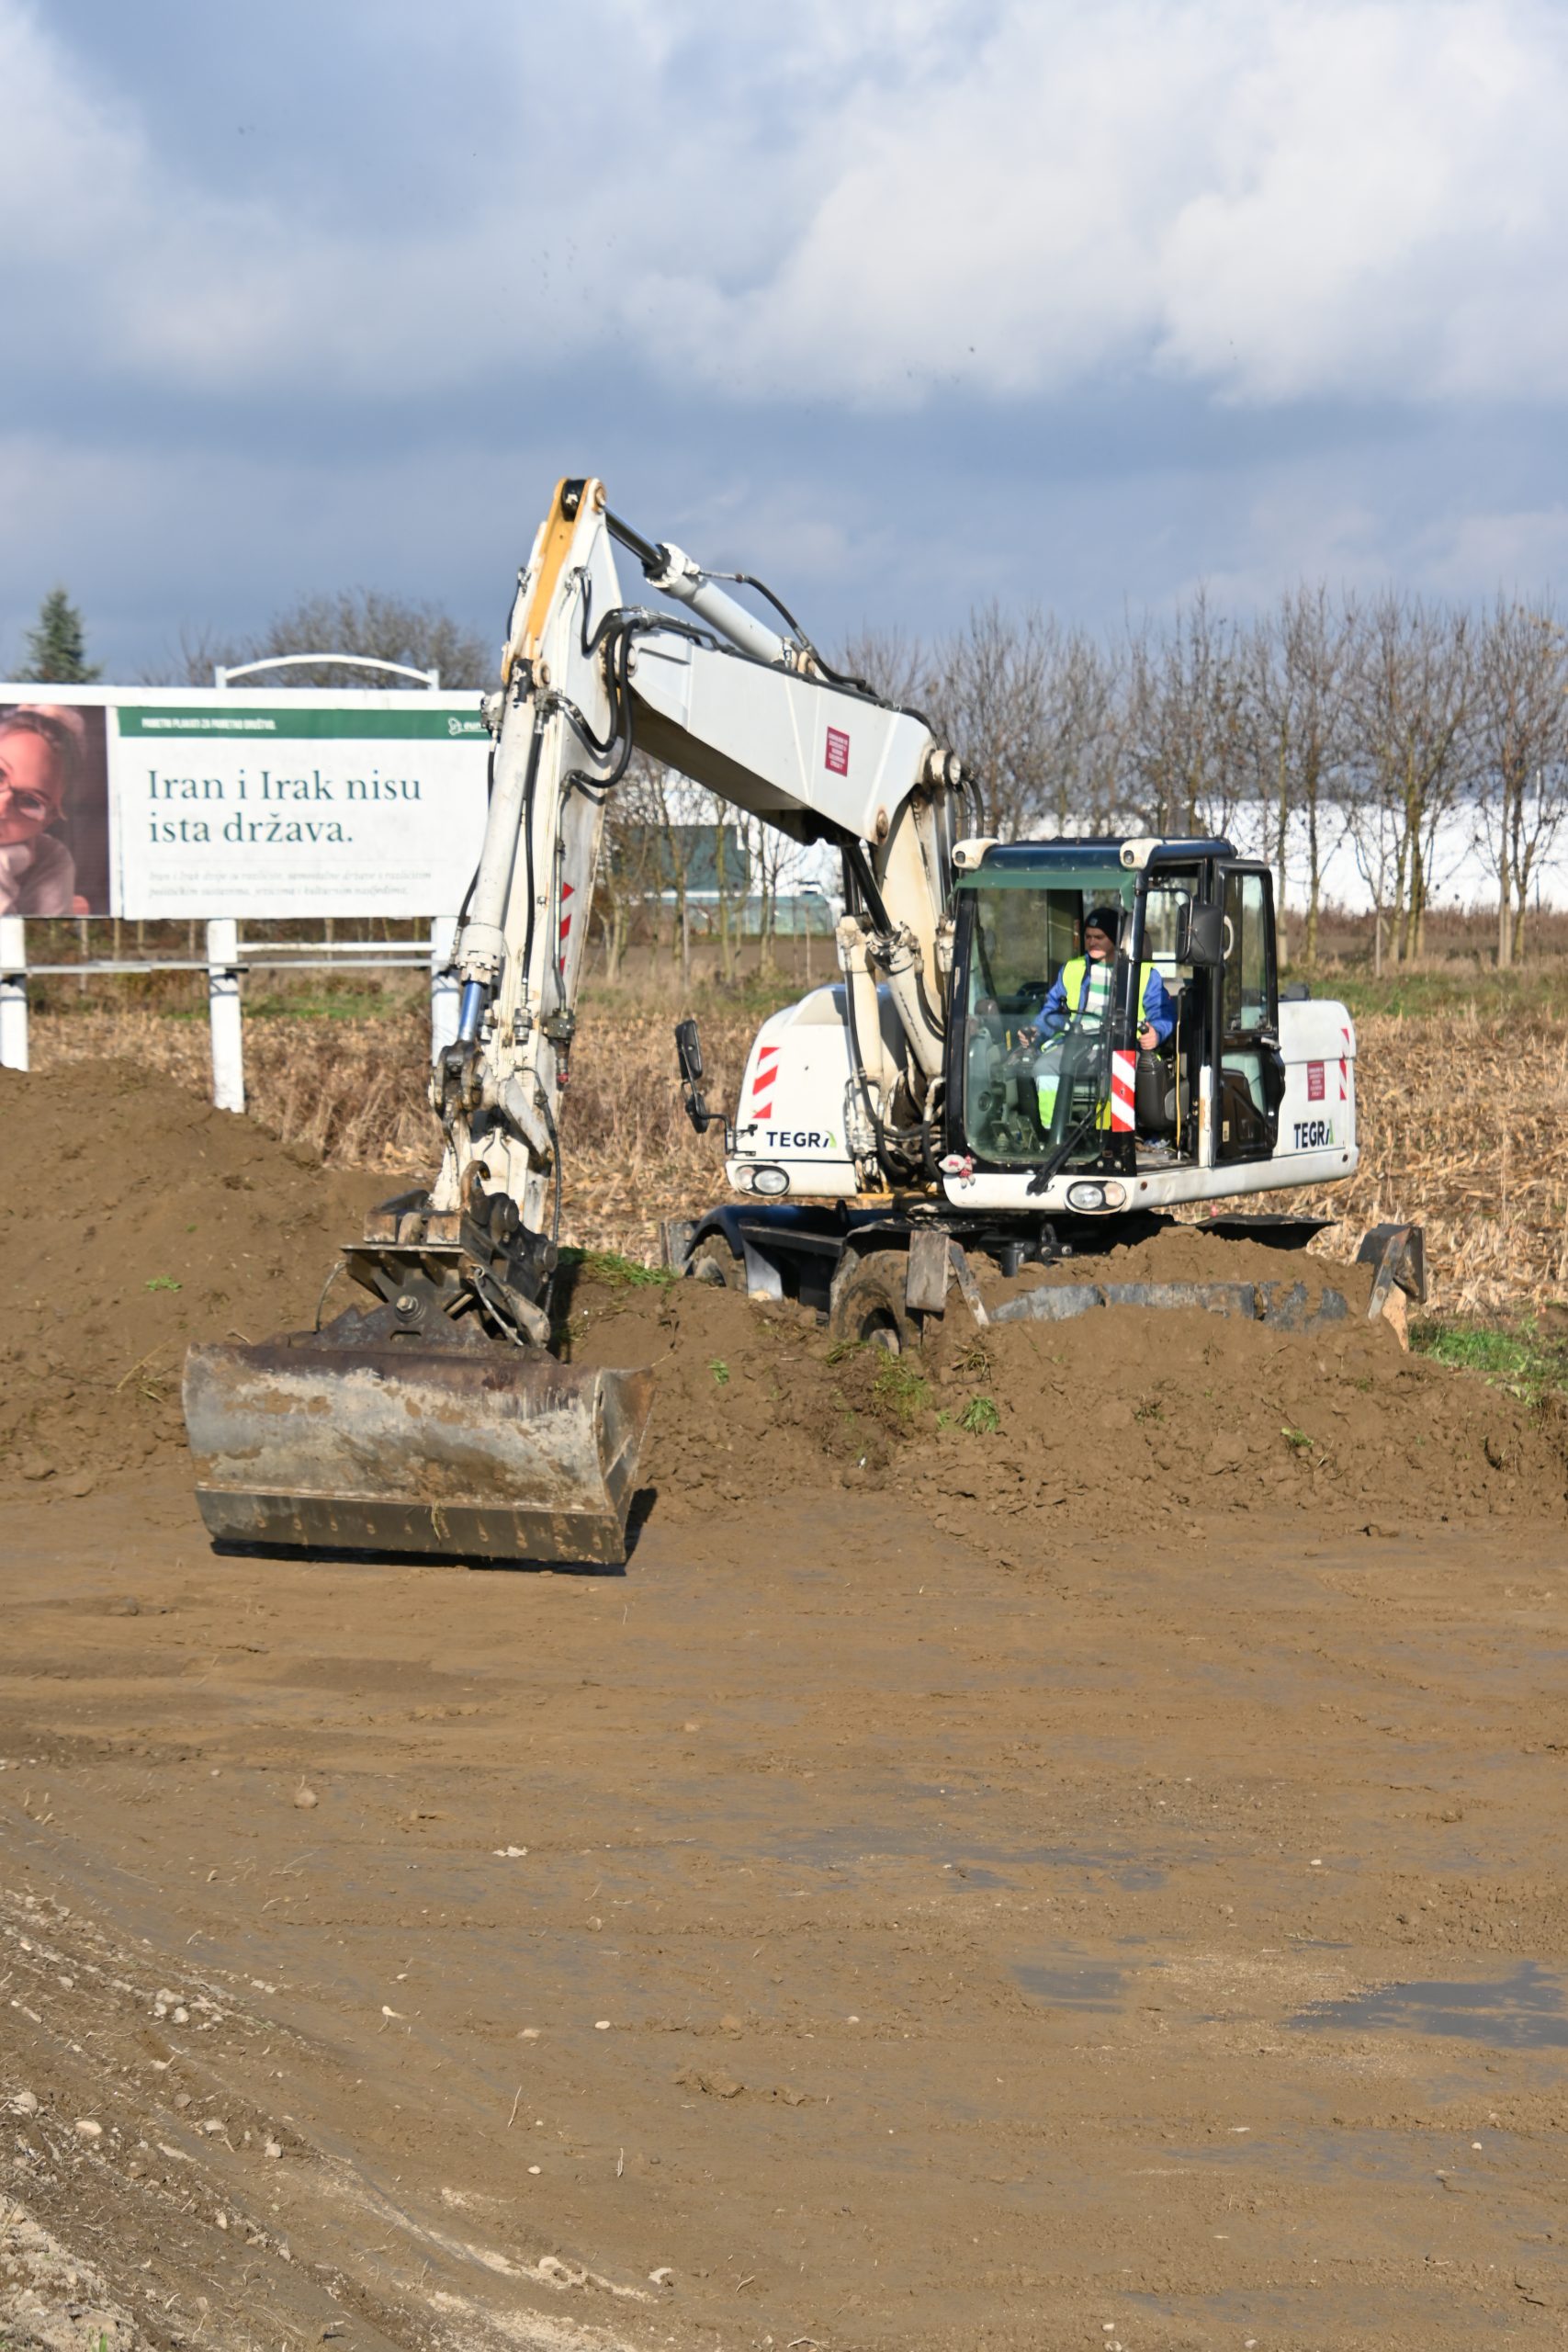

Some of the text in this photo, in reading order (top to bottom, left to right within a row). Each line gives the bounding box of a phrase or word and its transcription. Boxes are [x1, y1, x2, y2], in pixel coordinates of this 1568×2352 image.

[148, 769, 422, 800] Iran i Irak nisu
[149, 812, 353, 842] ista država.
[766, 1130, 837, 1148] TEGRA
[1293, 1119, 1334, 1149] TEGRA
